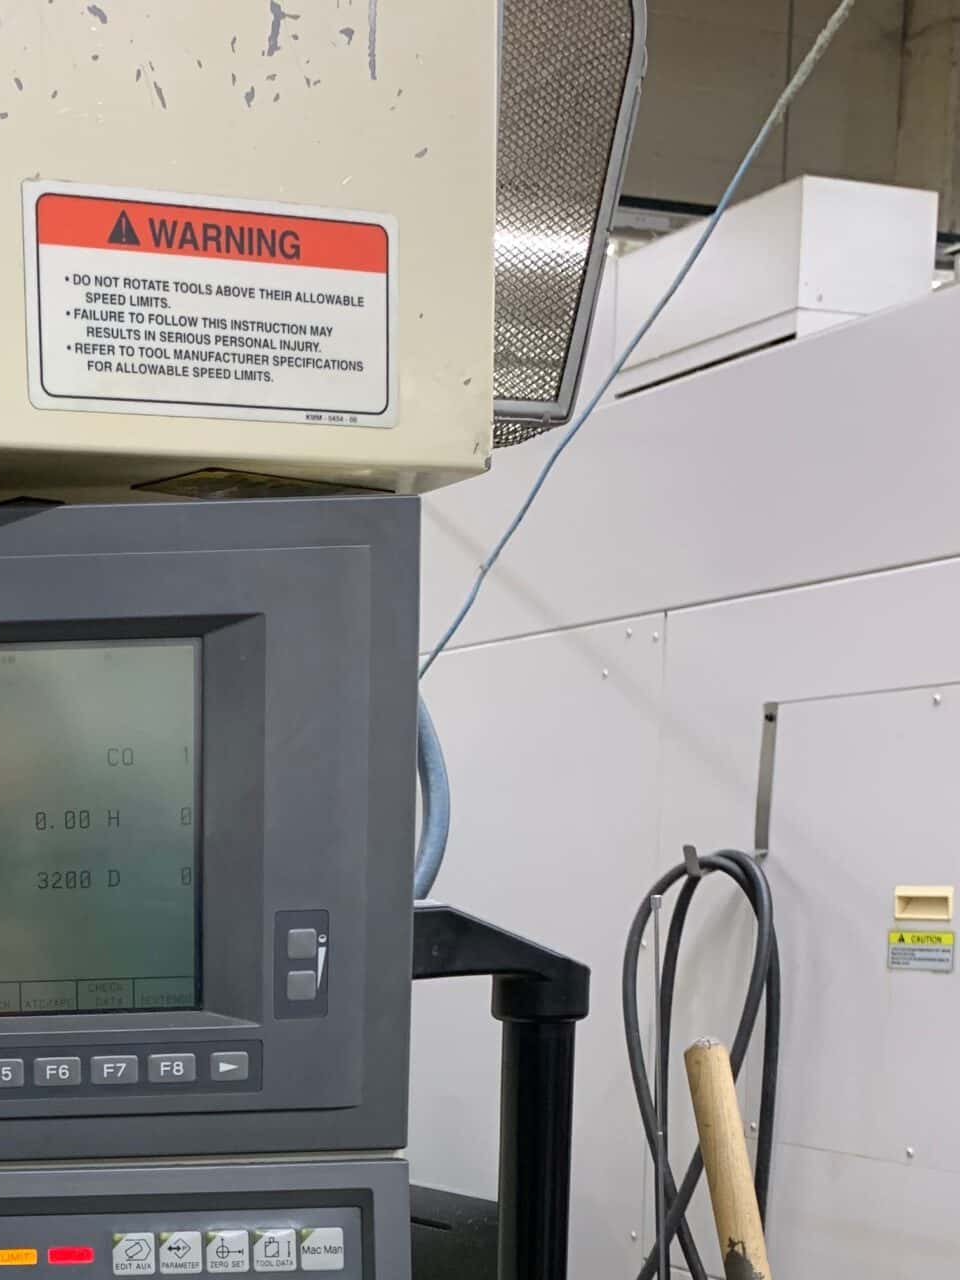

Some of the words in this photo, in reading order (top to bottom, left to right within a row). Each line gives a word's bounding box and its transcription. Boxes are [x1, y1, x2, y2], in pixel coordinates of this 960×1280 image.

[148, 217, 302, 260] WARNING
[73, 273, 91, 287] DO
[94, 274, 119, 289] NOT
[123, 276, 170, 292] ROTATE
[173, 281, 213, 296] TOOLS
[215, 284, 255, 299] ABOVE
[258, 288, 292, 302] THEIR
[295, 290, 365, 307] ALLOWABLE
[85, 292, 126, 307] SPEED
[129, 294, 172, 309] LIMITS.
[73, 308, 125, 323] FAILURE
[128, 312, 145, 325] TO
[147, 313, 198, 329] FOLLOW
[201, 316, 227, 331] THIS
[230, 318, 306, 336] INSTRUCTION
[310, 324, 333, 338] MAY
[86, 326, 141, 341] RESULTS
[144, 329, 156, 342] IN
[159, 330, 211, 346] SERIOUS
[214, 334, 275, 350] PERSONAL
[278, 339, 322, 354] INJURY.
[74, 342, 115, 356] REFER
[119, 345, 135, 358] TO
[138, 346, 170, 360] TOOL
[173, 348, 270, 367] MANUFACTURER
[272, 354, 364, 372] SPECIFICATIONS
[87, 360, 113, 373] FOR
[115, 362, 190, 378] ALLOWABLE
[192, 366, 231, 380] SPEED
[233, 368, 274, 383] LIMITS.
[34, 809, 92, 832] 0.00
[106, 809, 121, 829] H
[37, 869, 92, 891] 3200
[45, 1064, 70, 1080] F6
[102, 1063, 127, 1078] F7
[159, 1061, 185, 1077] F8
[302, 1245, 321, 1255] Mac
[324, 1244, 343, 1255] Man
[115, 1262, 133, 1271] EDIT
